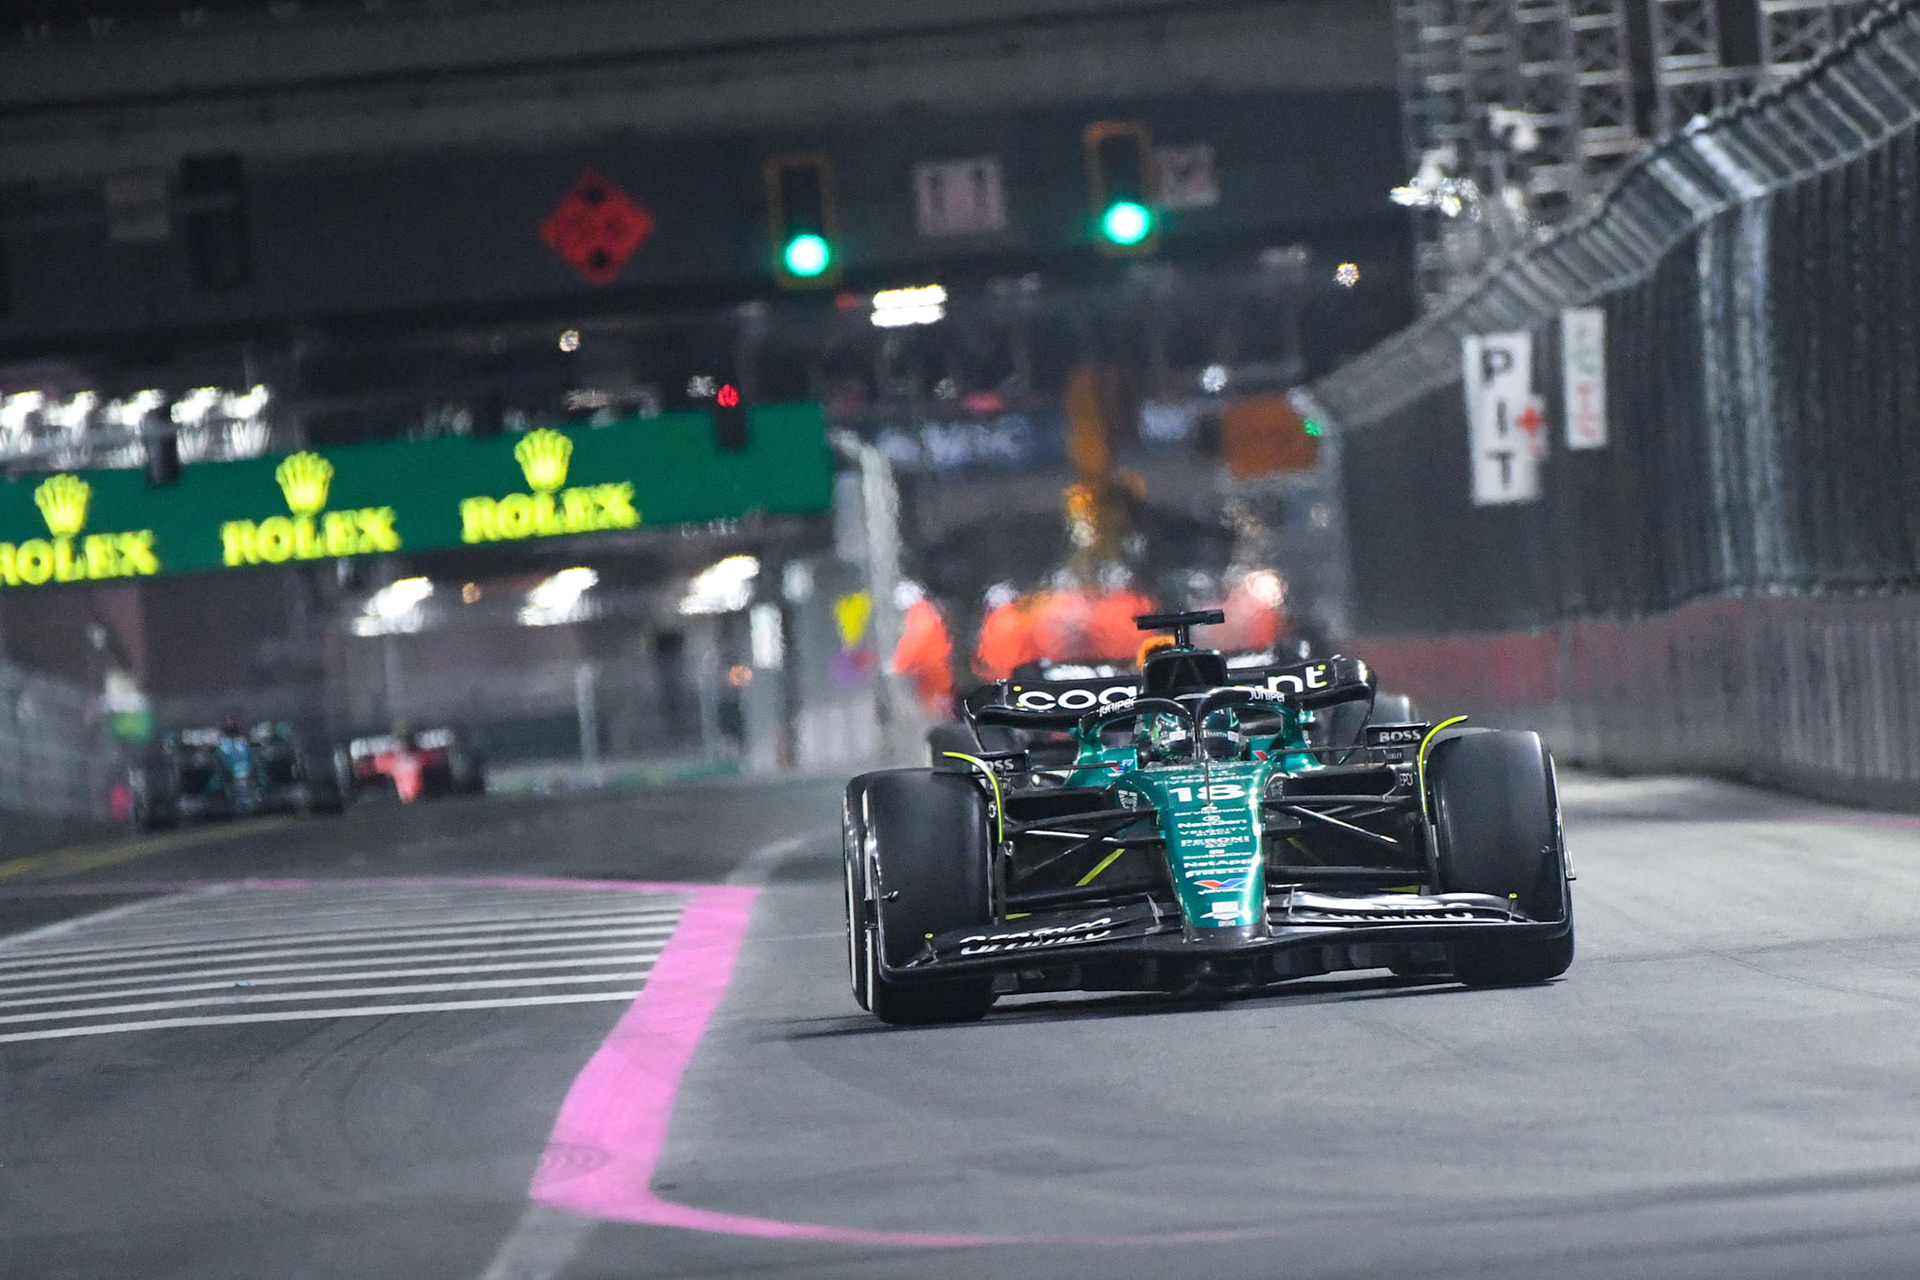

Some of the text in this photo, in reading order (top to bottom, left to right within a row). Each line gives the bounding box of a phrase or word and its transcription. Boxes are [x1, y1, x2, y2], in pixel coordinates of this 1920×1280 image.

[1480, 347, 1514, 490] PIT
[459, 481, 641, 544] ROLEX
[222, 507, 399, 566] ROLEX
[1379, 730, 1421, 743] BOSS
[1169, 784, 1245, 802] 18
[1181, 836, 1250, 847] PERONI
[1183, 859, 1253, 869] NetApp
